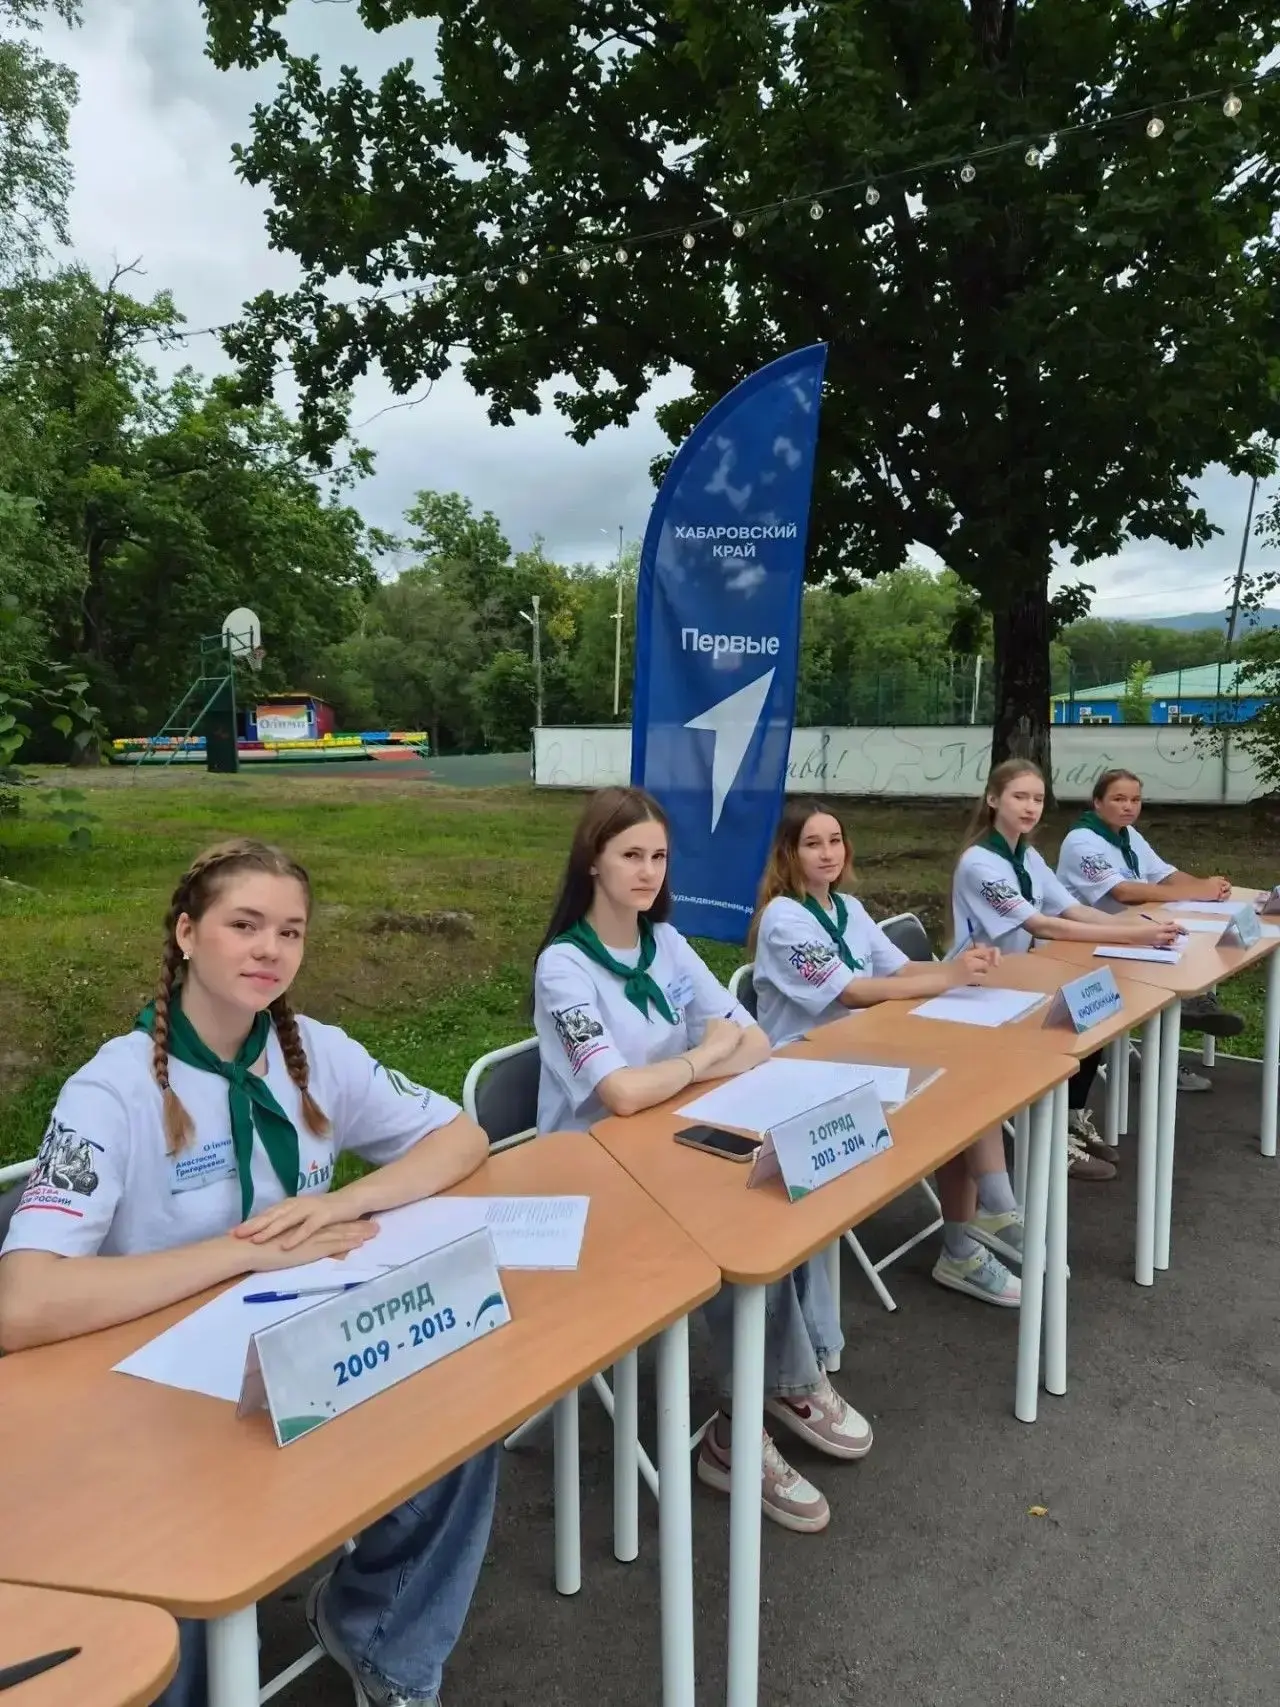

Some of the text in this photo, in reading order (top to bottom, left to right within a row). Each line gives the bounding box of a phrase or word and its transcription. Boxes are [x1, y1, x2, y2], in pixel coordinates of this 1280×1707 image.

[675, 523, 798, 540] ХАБАРОВСКИЙ
[713, 542, 756, 558] КРАЙ
[681, 627, 780, 660] Первые
[809, 1113, 856, 1145] 2 ОТРЯД
[811, 1148, 836, 1171] 2013
[842, 1133, 866, 1156] 2014
[340, 1282, 436, 1342] 1 ОТРЯД
[333, 1340, 391, 1387] 2009
[408, 1307, 457, 1347] 2013
